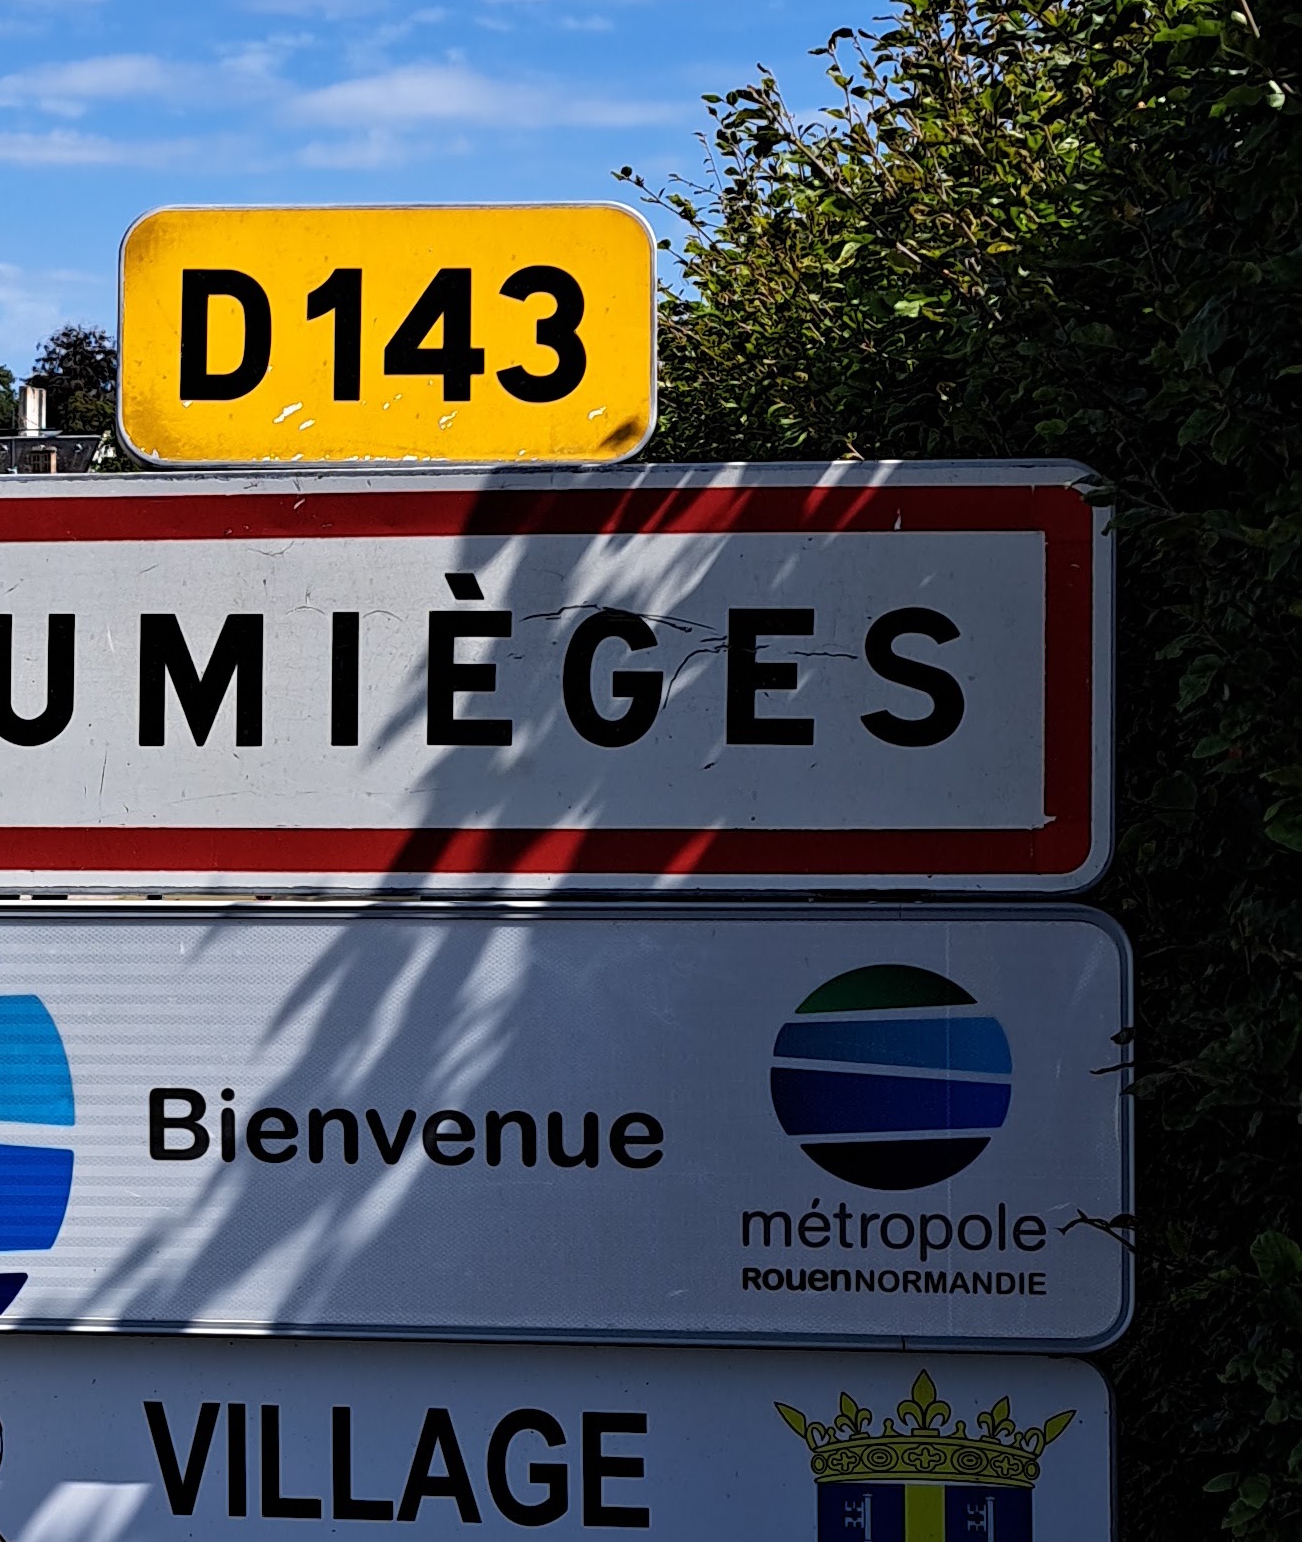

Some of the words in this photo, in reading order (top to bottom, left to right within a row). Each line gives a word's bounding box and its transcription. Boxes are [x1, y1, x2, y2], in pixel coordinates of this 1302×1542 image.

[180, 265, 586, 402] D143
[147, 1086, 665, 1170] Bienvenue
[742, 1197, 1047, 1262] métropole
[144, 1401, 651, 1529] VILLAGE
